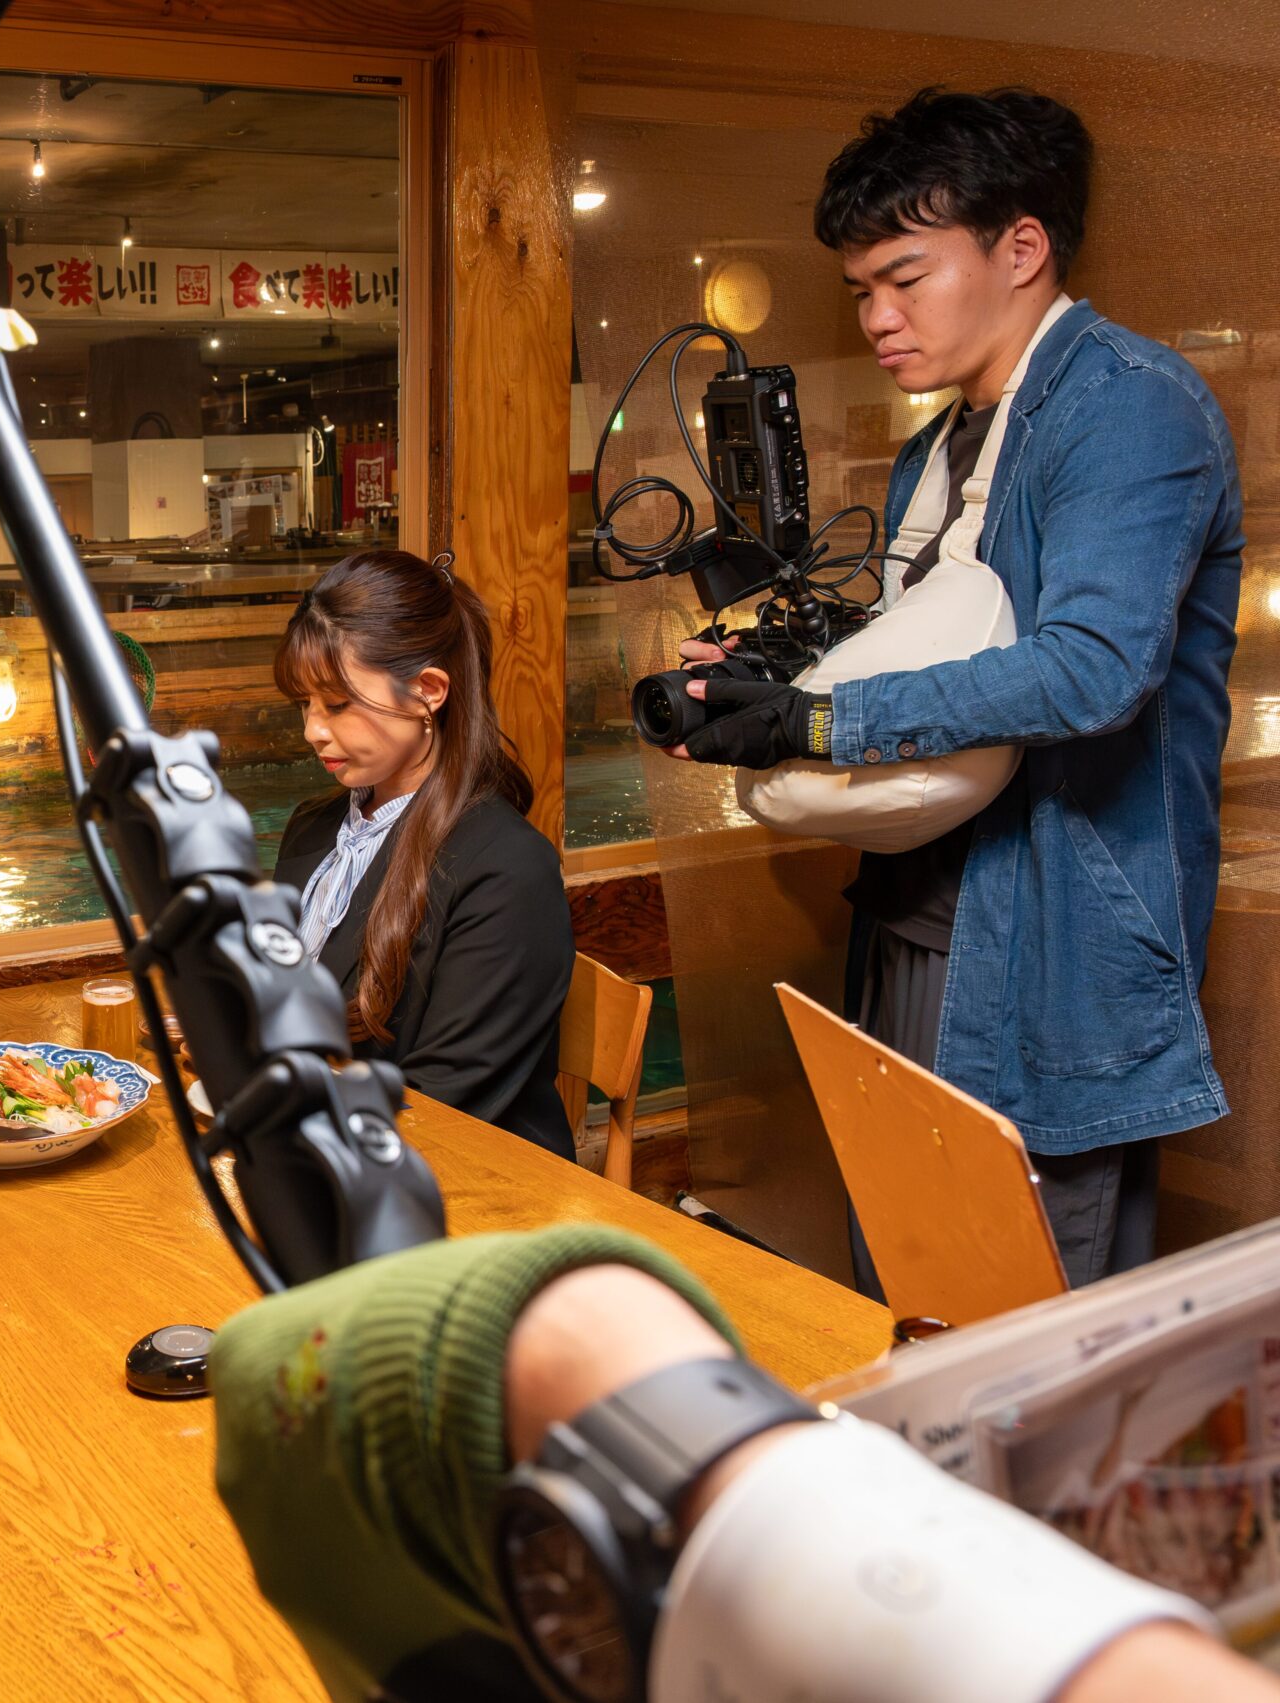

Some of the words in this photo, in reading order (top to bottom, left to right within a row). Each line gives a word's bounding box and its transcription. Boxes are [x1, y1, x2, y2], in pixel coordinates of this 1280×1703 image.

[8, 256, 157, 308] って楽しい!!
